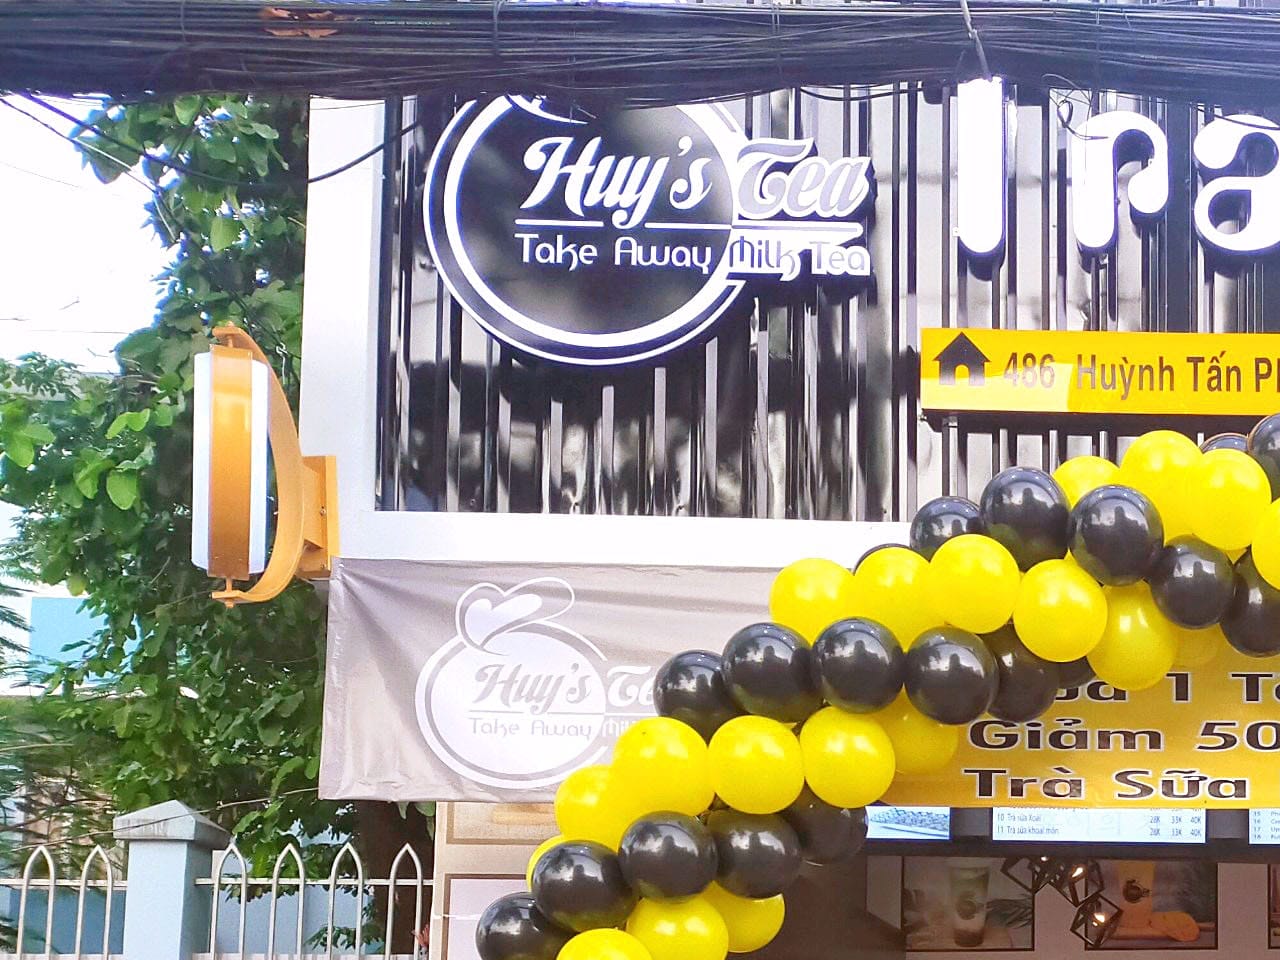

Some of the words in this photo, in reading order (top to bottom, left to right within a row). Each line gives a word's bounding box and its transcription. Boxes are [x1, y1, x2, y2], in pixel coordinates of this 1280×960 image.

[520, 136, 713, 230] Huy's
[737, 136, 873, 219] Tea
[515, 233, 598, 272] Take
[614, 236, 713, 274] Away
[729, 235, 797, 276] Milk
[811, 240, 869, 273] Tea
[1002, 351, 1056, 391] 486
[1076, 352, 1175, 400] Huỳnh
[1185, 347, 1244, 394] Tấn
[472, 663, 592, 716] Huy's
[1166, 672, 1192, 702] 1
[470, 717, 520, 738] Take
[530, 718, 592, 741] Away
[969, 717, 1163, 751] Giảm
[963, 766, 1083, 799] Trà
[1113, 769, 1248, 799] Sữa
